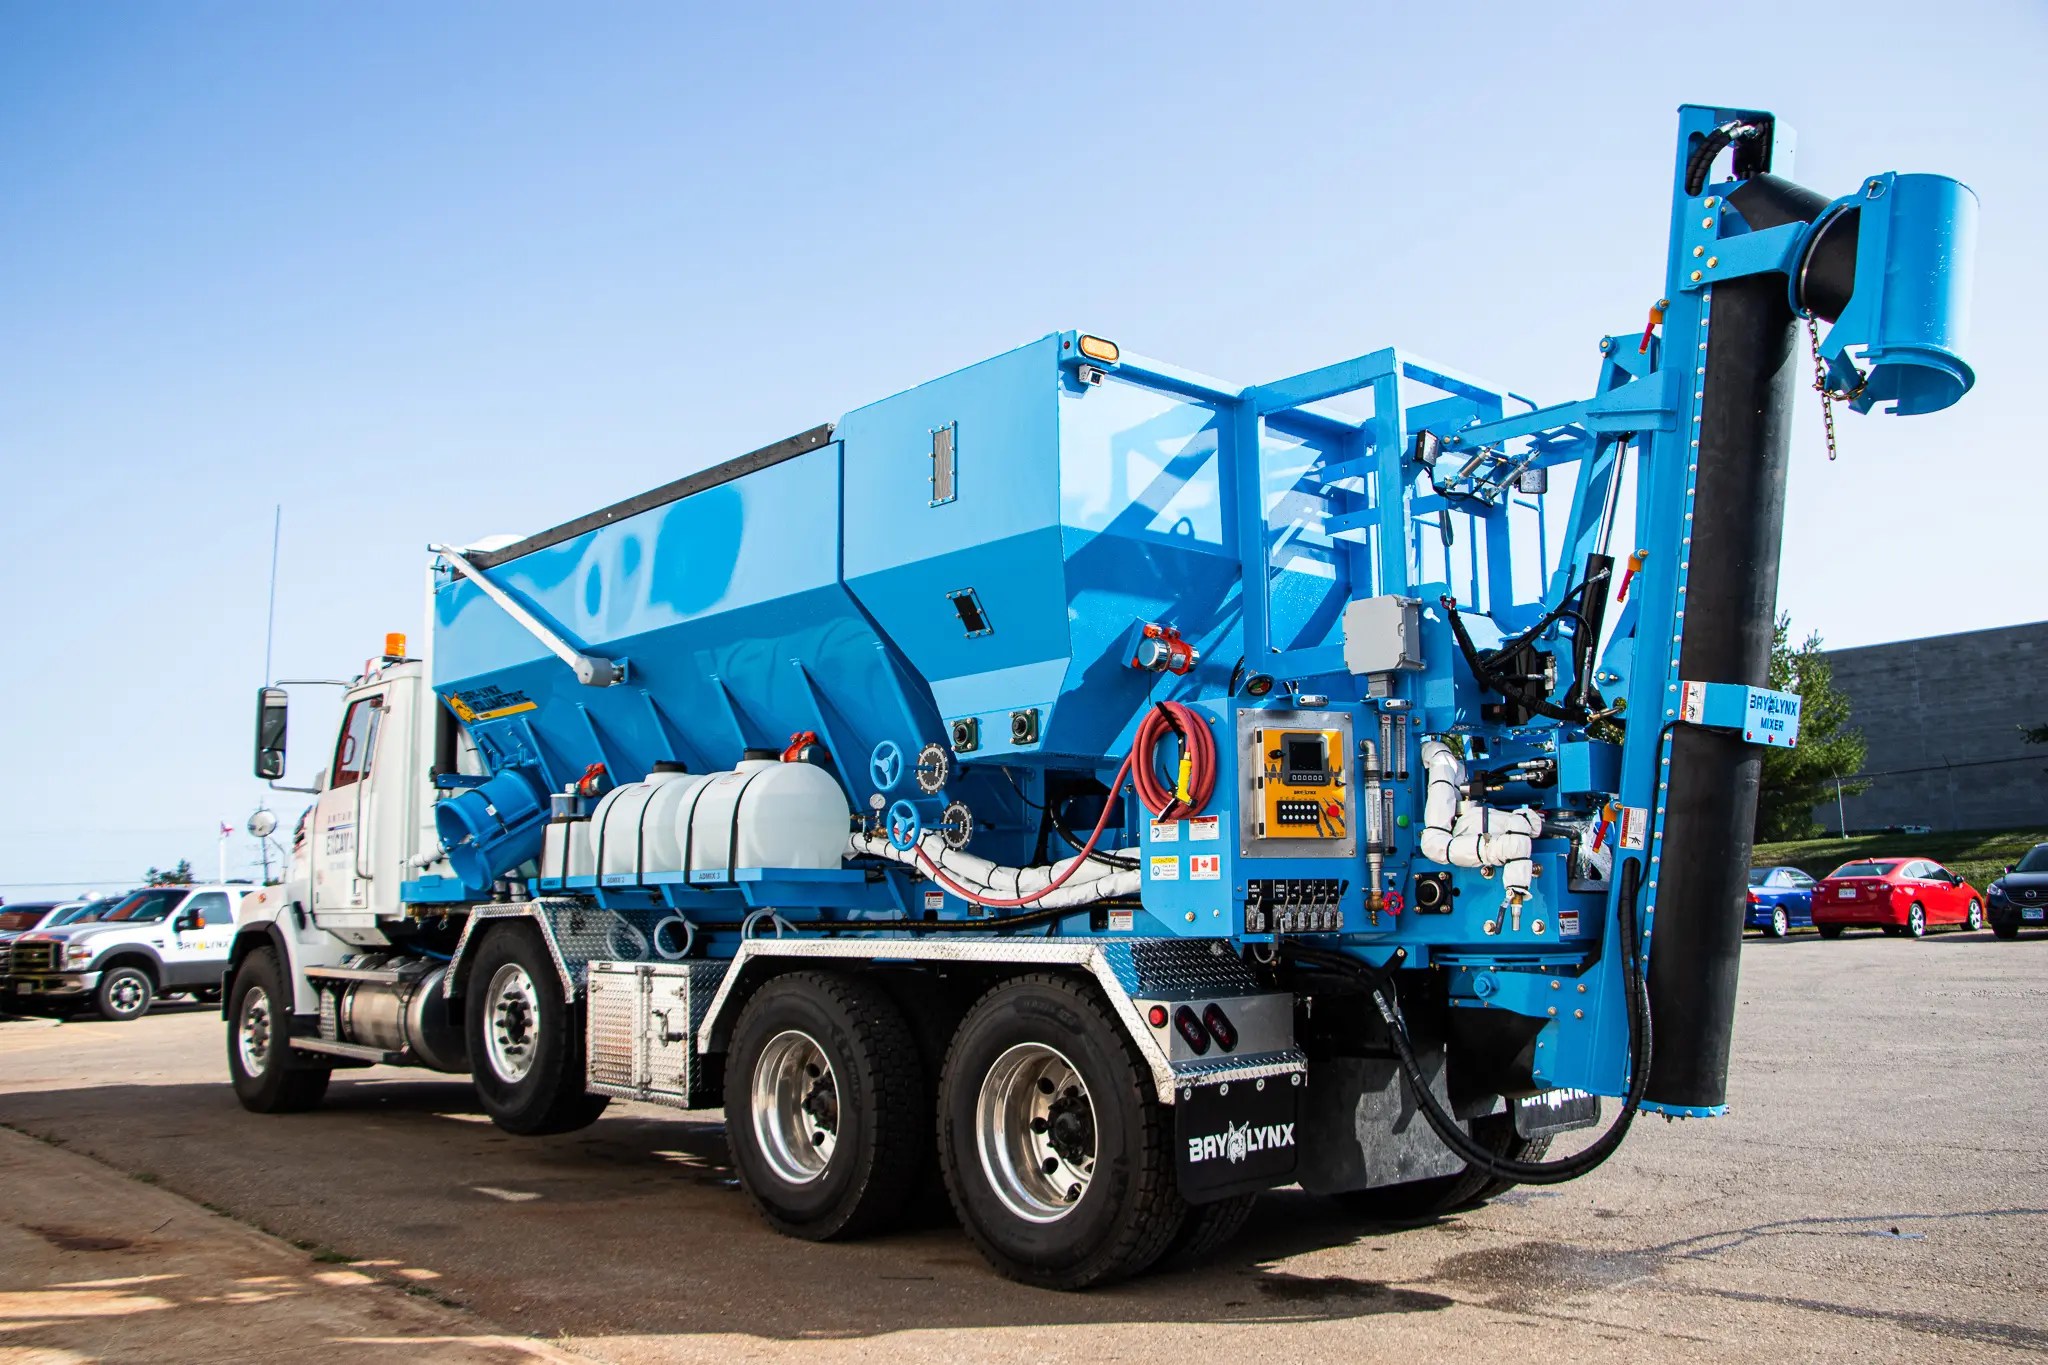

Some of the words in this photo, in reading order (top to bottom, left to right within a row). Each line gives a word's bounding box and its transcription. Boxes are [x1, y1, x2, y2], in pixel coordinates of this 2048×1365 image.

[1760, 717, 1784, 731] MIXER
[698, 872, 716, 880] ADMIX
[1189, 1133, 1228, 1162] BAY
[1247, 1123, 1295, 1151] LYNX
